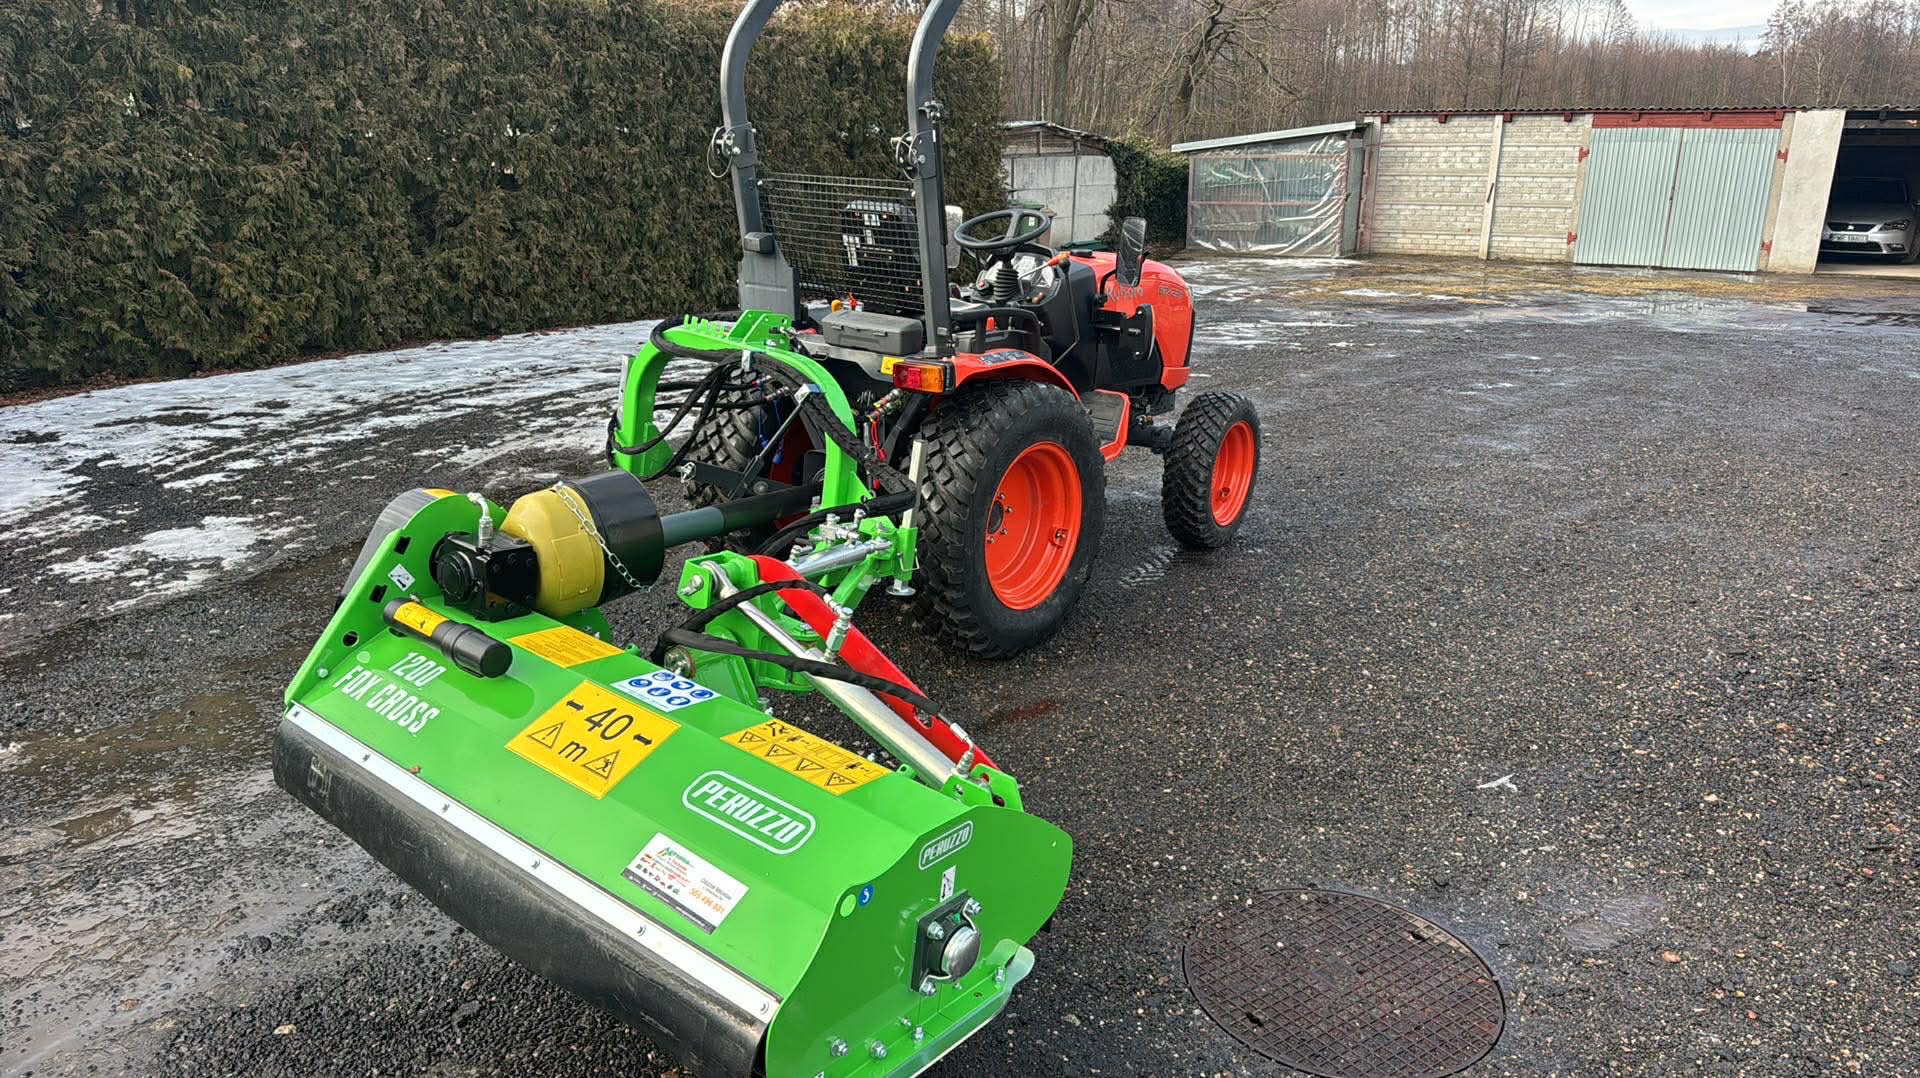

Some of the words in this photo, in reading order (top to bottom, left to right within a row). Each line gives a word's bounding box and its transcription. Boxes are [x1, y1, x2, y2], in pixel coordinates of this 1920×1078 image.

[388, 652, 447, 687] 1200
[332, 665, 384, 701] FOX
[366, 683, 440, 734] CROSS
[584, 707, 634, 741] 40
[558, 740, 588, 762] m
[691, 779, 807, 844] PERUZZO
[922, 826, 970, 865] PERUZZO
